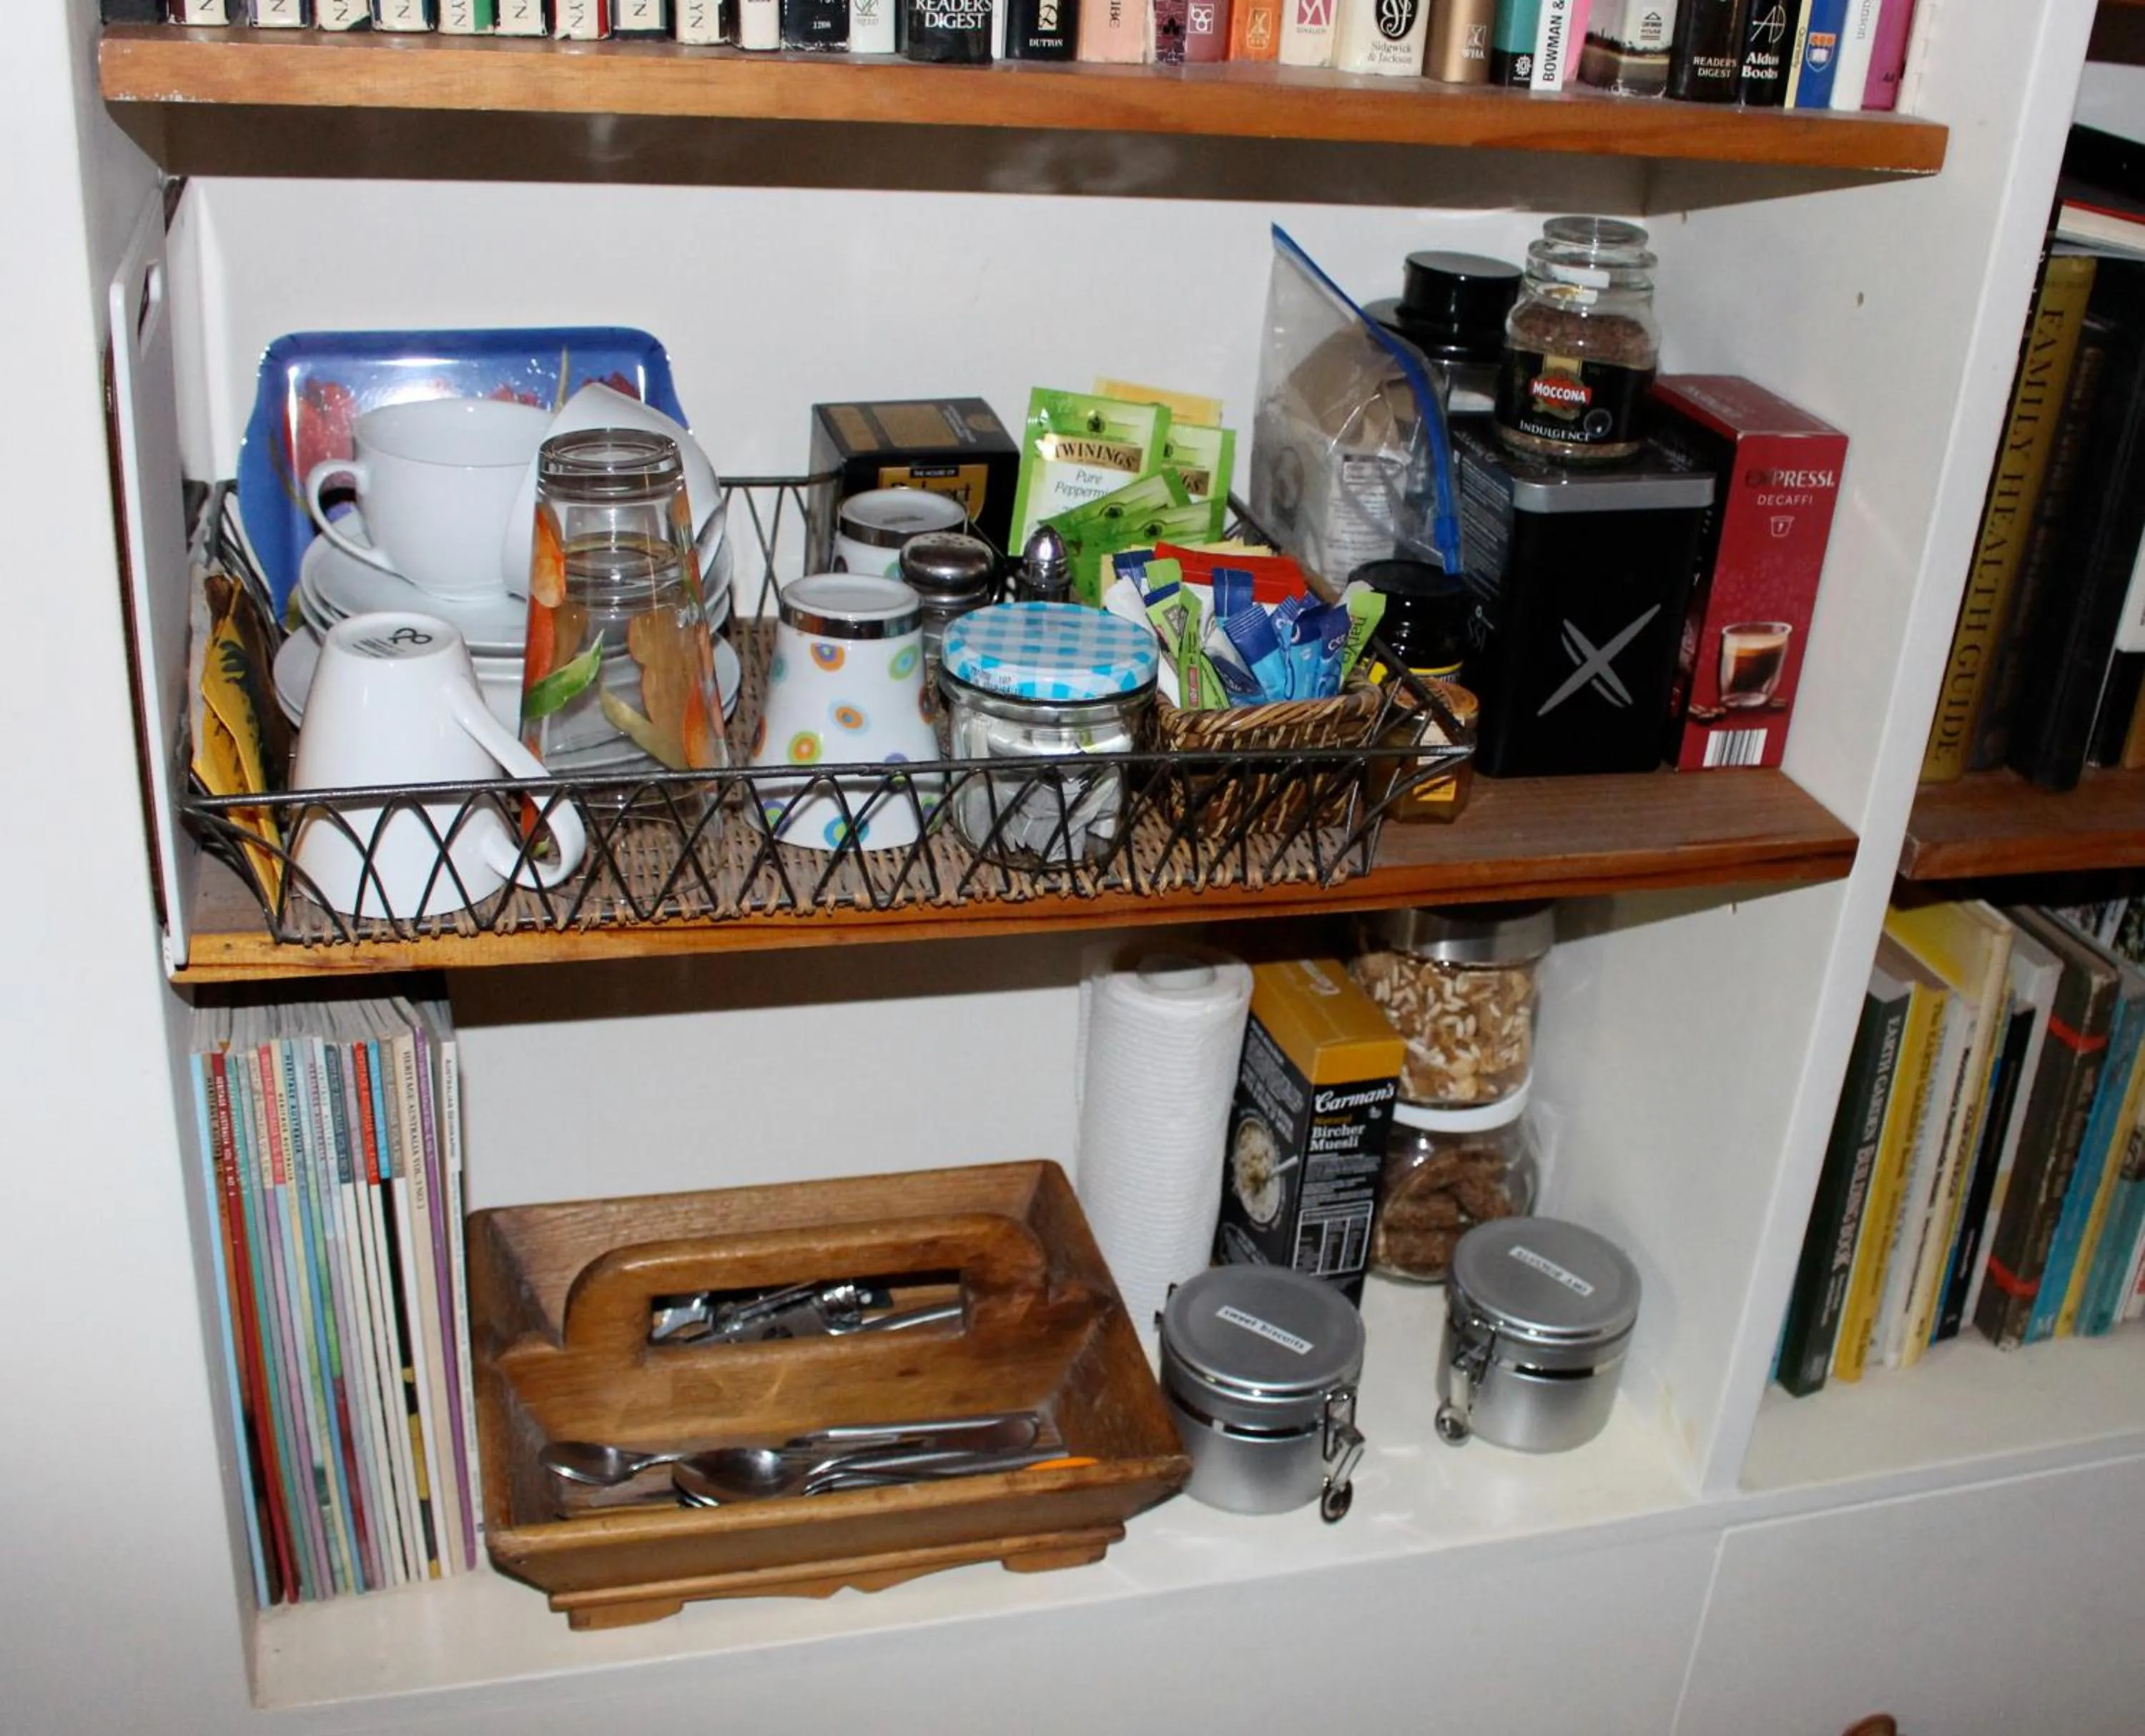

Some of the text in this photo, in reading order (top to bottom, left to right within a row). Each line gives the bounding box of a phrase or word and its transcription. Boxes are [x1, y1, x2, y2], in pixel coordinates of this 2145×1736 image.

[925, 12, 985, 29] DIGEST
[1029, 38, 1063, 47] DUTTON
[1371, 41, 1412, 53] Sidgwick
[1542, 15, 1564, 82] BOWMAN
[1377, 52, 1412, 64] Jackson
[1745, 51, 1780, 66] Aldus
[1697, 68, 1732, 79] DIGEST
[1741, 64, 1779, 80] Books
[1532, 380, 1587, 403] MOCCONA
[1519, 420, 1590, 442] INDULGENCE
[1055, 442, 1135, 470] TWININGS
[1075, 470, 1103, 484] Pure
[1933, 307, 2063, 764] FAMILY HEALTH GUIDE
[402, 1050, 415, 1100] HERITAGE
[1315, 1082, 1396, 1113] Carman's
[407, 1103, 420, 1155] AUSTRALIA
[1311, 1123, 1366, 1139] Bircher
[1308, 1135, 1359, 1152] Muesli
